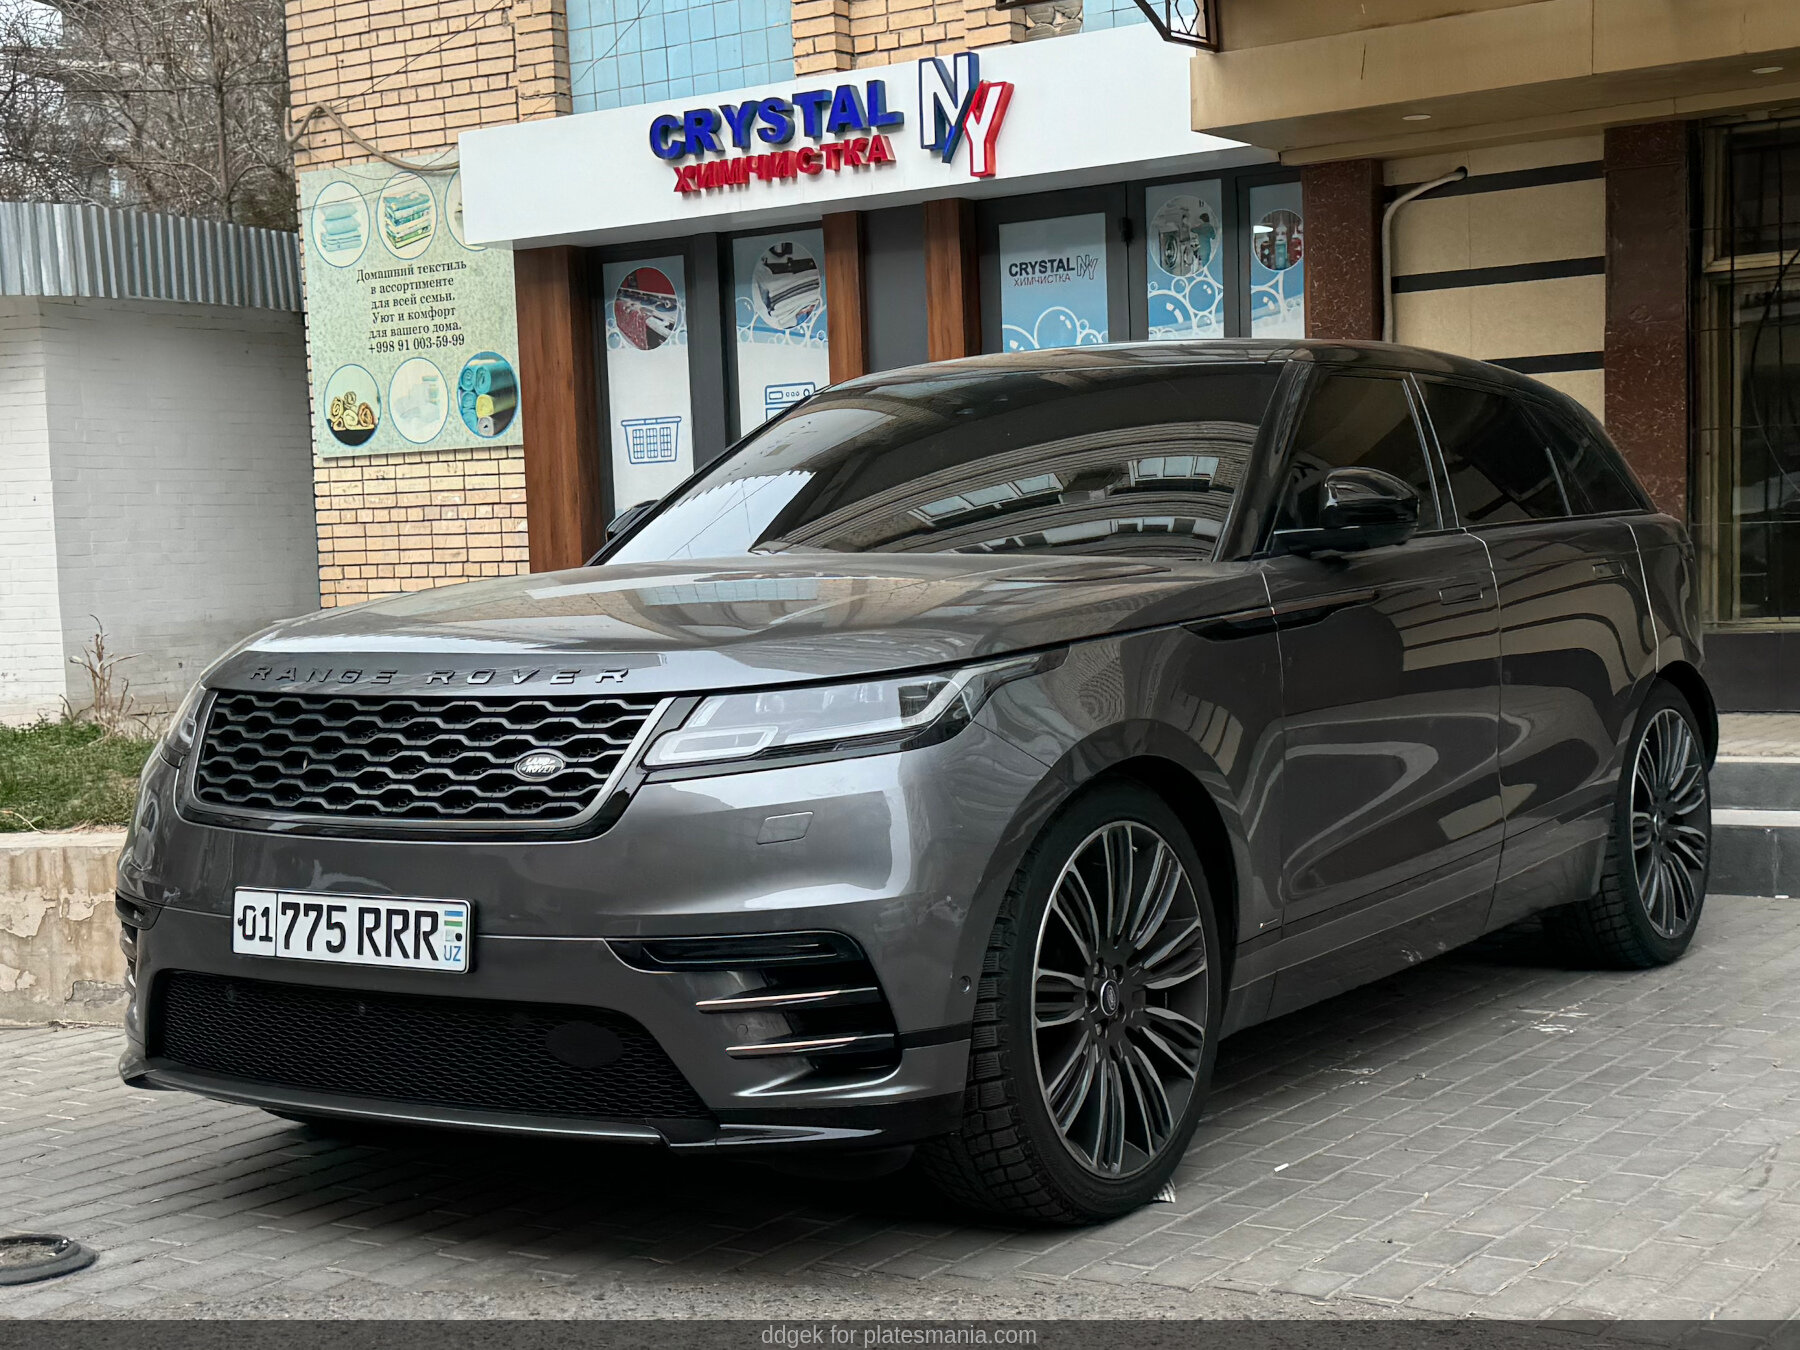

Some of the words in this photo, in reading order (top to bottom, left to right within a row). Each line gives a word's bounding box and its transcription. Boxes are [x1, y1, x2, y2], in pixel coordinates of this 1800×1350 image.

[649, 79, 904, 161] CRYSTAL
[918, 51, 1015, 178] NY
[673, 134, 897, 196] ХИМЧИСТКА
[356, 263, 414, 283] Домашний
[417, 260, 467, 275] текстиль
[1009, 257, 1075, 277] CRYSTAL
[370, 286, 377, 295] в
[379, 277, 454, 294] ассортименте
[1013, 273, 1071, 287] ХИМЧИСТКА
[371, 299, 390, 310] для
[393, 293, 417, 307] всей
[420, 292, 456, 304] семьи.
[372, 312, 395, 324] Уют
[398, 312, 405, 321] и
[408, 306, 456, 321] комфорт
[368, 329, 388, 340] для
[390, 325, 430, 337] вашего
[432, 321, 462, 333] дома.
[368, 340, 395, 354] +998
[398, 339, 410, 351] 91
[413, 333, 465, 350] 003-59-99
[250, 667, 398, 684] RANGE
[425, 668, 629, 685] ROVER
[241, 905, 273, 943] 01
[443, 944, 462, 962] UZ
